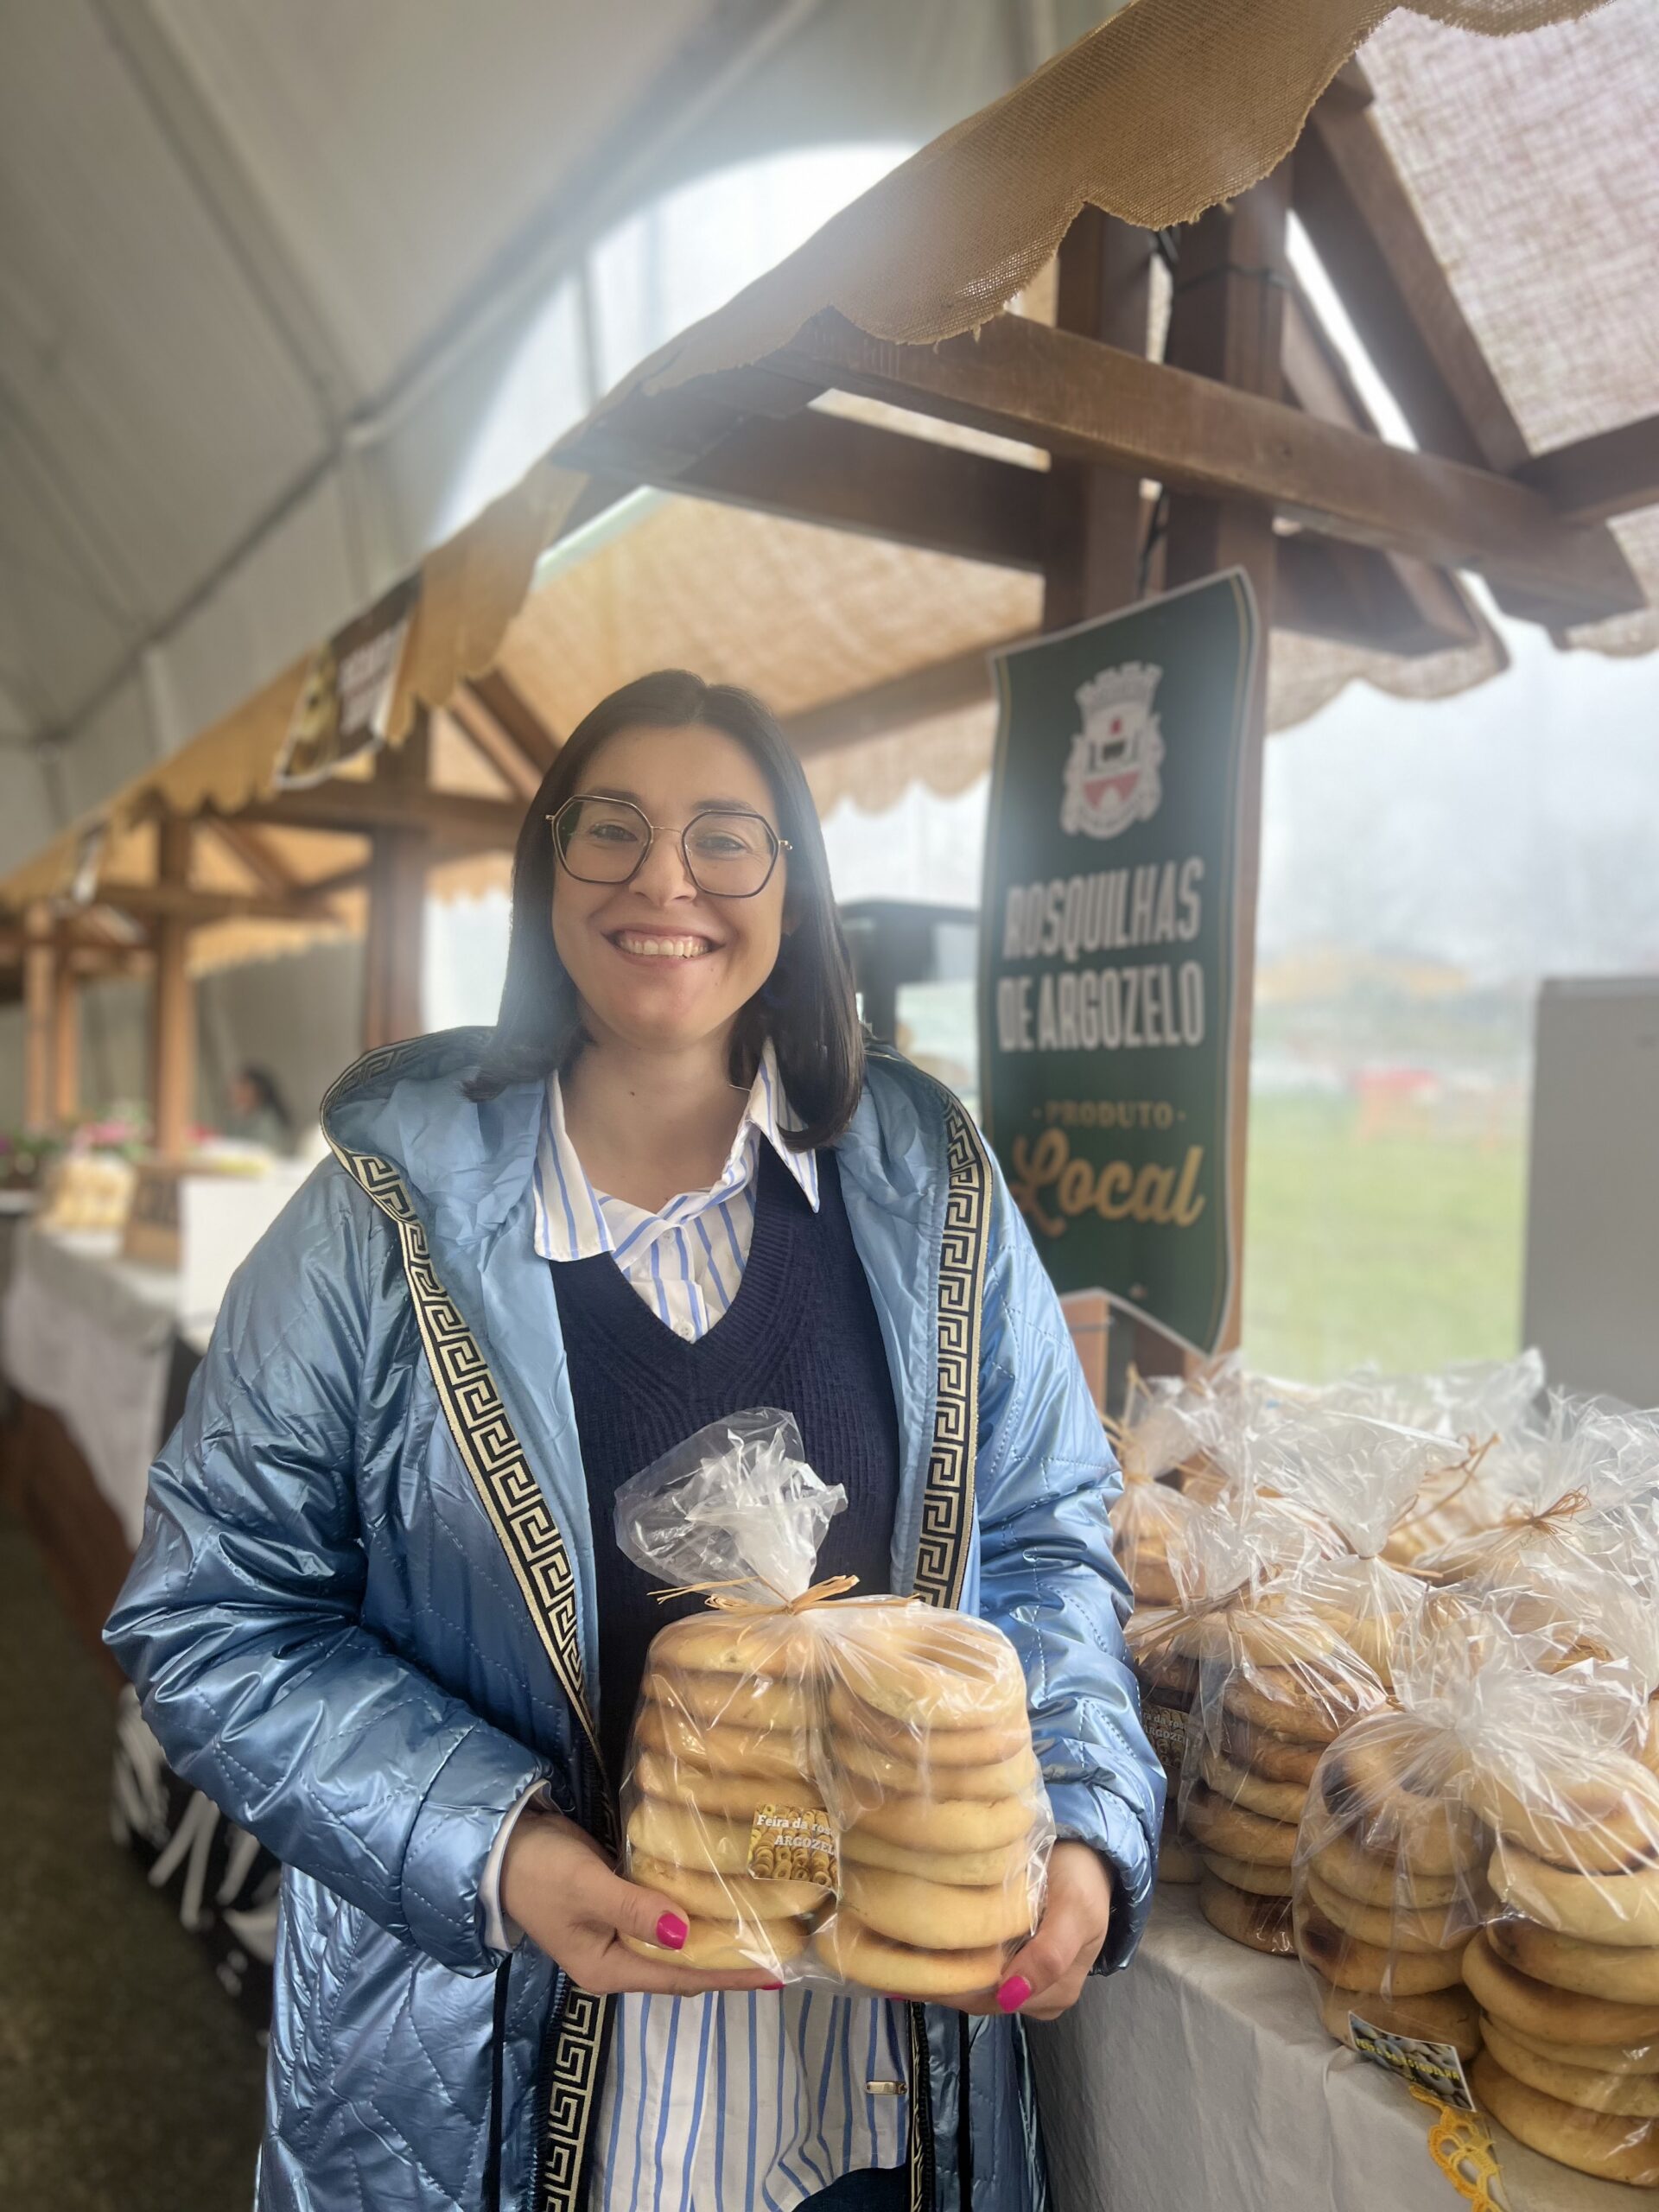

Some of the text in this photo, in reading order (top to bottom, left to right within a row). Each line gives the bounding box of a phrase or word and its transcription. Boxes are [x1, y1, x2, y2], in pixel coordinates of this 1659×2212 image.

[1003, 858, 1204, 963] ROSQUILHAS
[997, 961, 1206, 1053] DE ARGOZELO
[1045, 1100, 1174, 1129] PRODUTO
[1008, 1127, 1206, 1238] Local
[756, 1814, 831, 1835] Feira da ros
[774, 1834, 835, 1856] ARGOZEL
